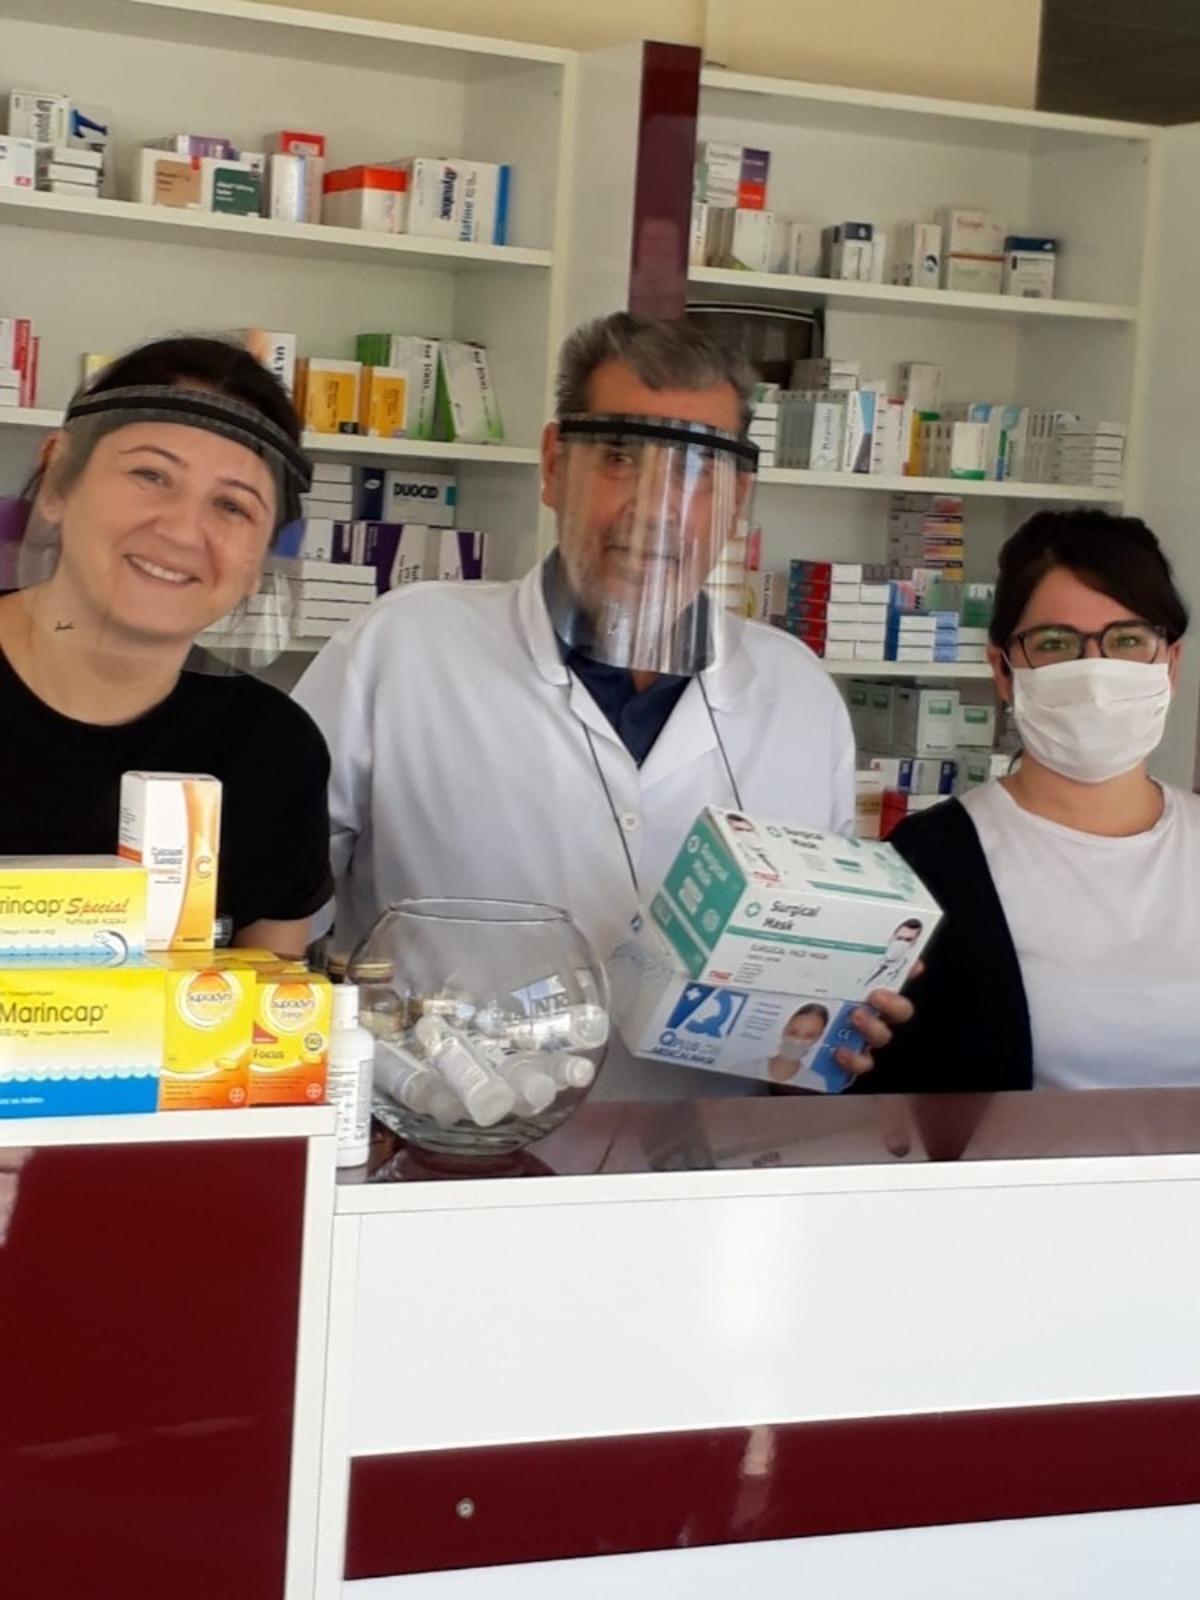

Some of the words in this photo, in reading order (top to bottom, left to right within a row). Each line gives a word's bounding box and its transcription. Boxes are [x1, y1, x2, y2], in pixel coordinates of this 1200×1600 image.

[393, 482, 439, 499] DUOCID
[65, 897, 131, 916] Special
[769, 900, 820, 918] Surgical
[762, 917, 794, 931] Mask
[252, 1047, 285, 1060] Focus
